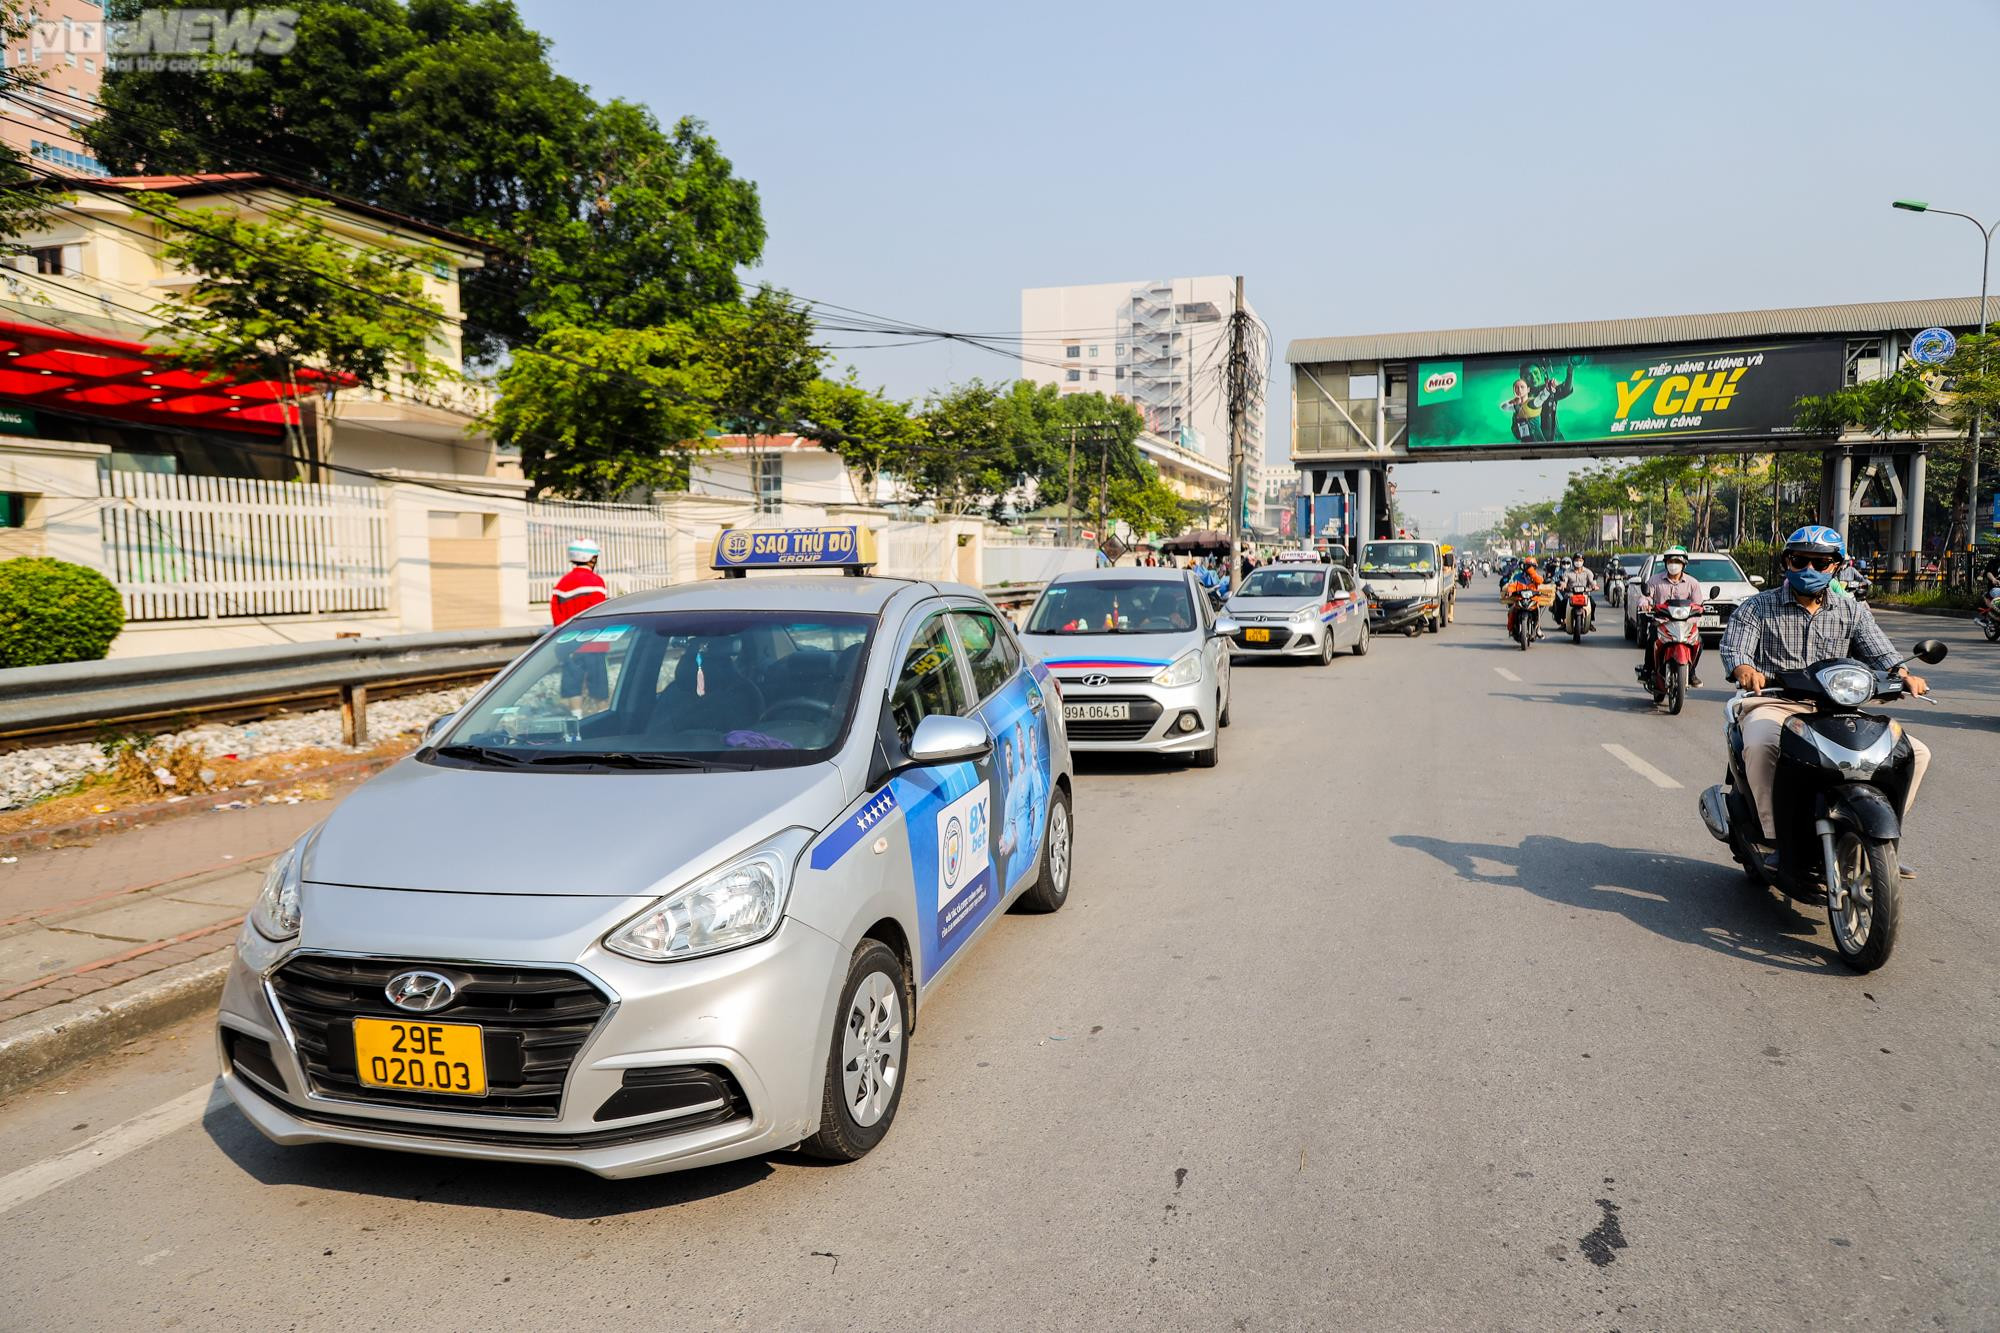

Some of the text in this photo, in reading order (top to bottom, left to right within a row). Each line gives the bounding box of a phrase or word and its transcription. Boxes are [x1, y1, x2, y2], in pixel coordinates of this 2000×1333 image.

[1648, 353, 1764, 377] TIẾP NĂNG LƯỢNG VÀ
[1429, 377, 1454, 388] MILO
[1615, 369, 1655, 419] Ý
[1630, 418, 1667, 431] THÀNH
[1670, 415, 1702, 427] CÔNG
[754, 535, 789, 554] SAO
[391, 1025, 445, 1055] 29E
[372, 1056, 471, 1090] 020.03
